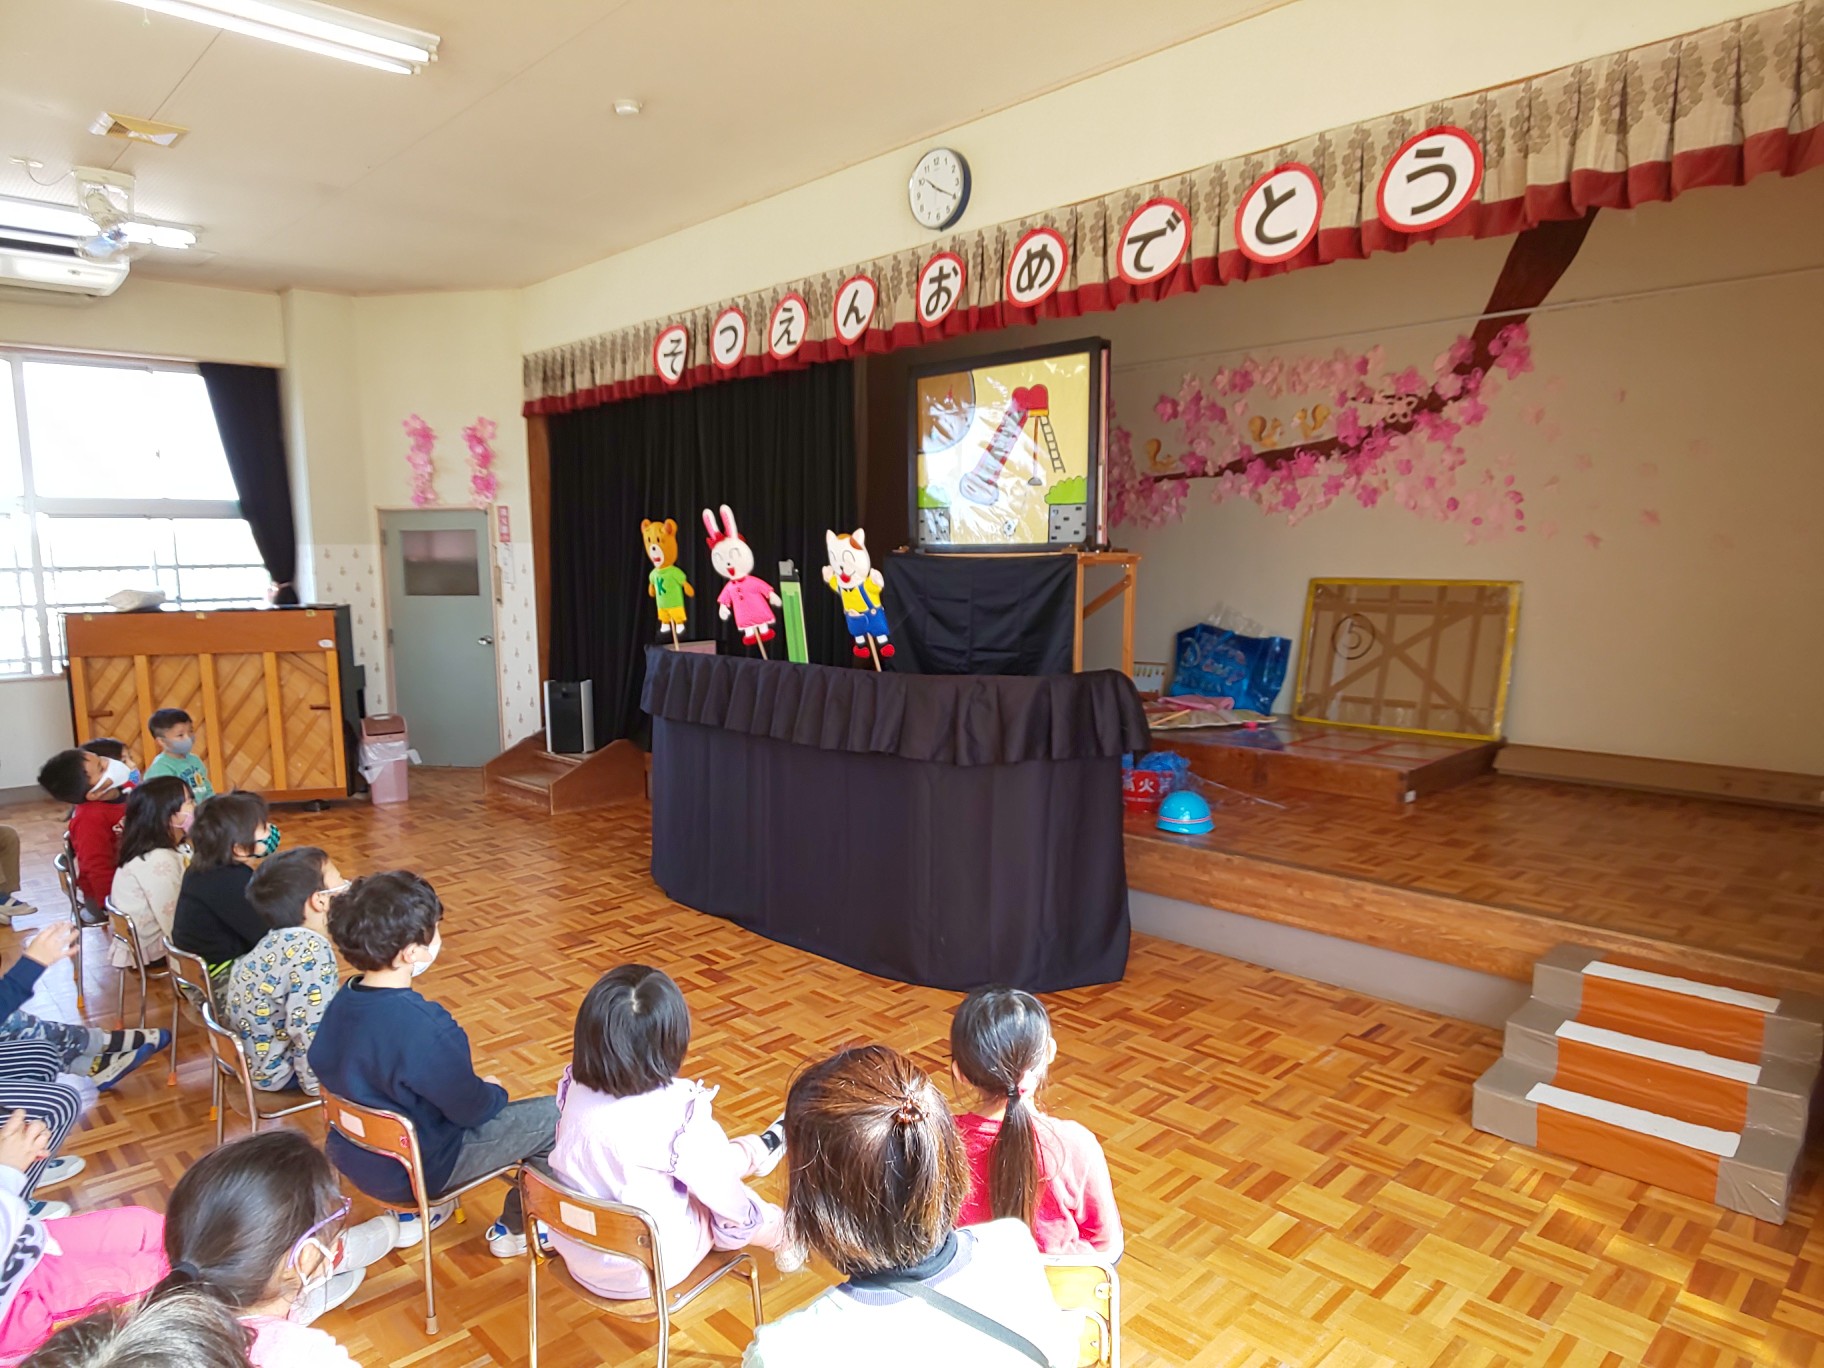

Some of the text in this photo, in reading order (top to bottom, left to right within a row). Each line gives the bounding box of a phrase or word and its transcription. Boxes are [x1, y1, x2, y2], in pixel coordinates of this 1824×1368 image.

[662, 145, 1459, 376] そつえんおめでとう
